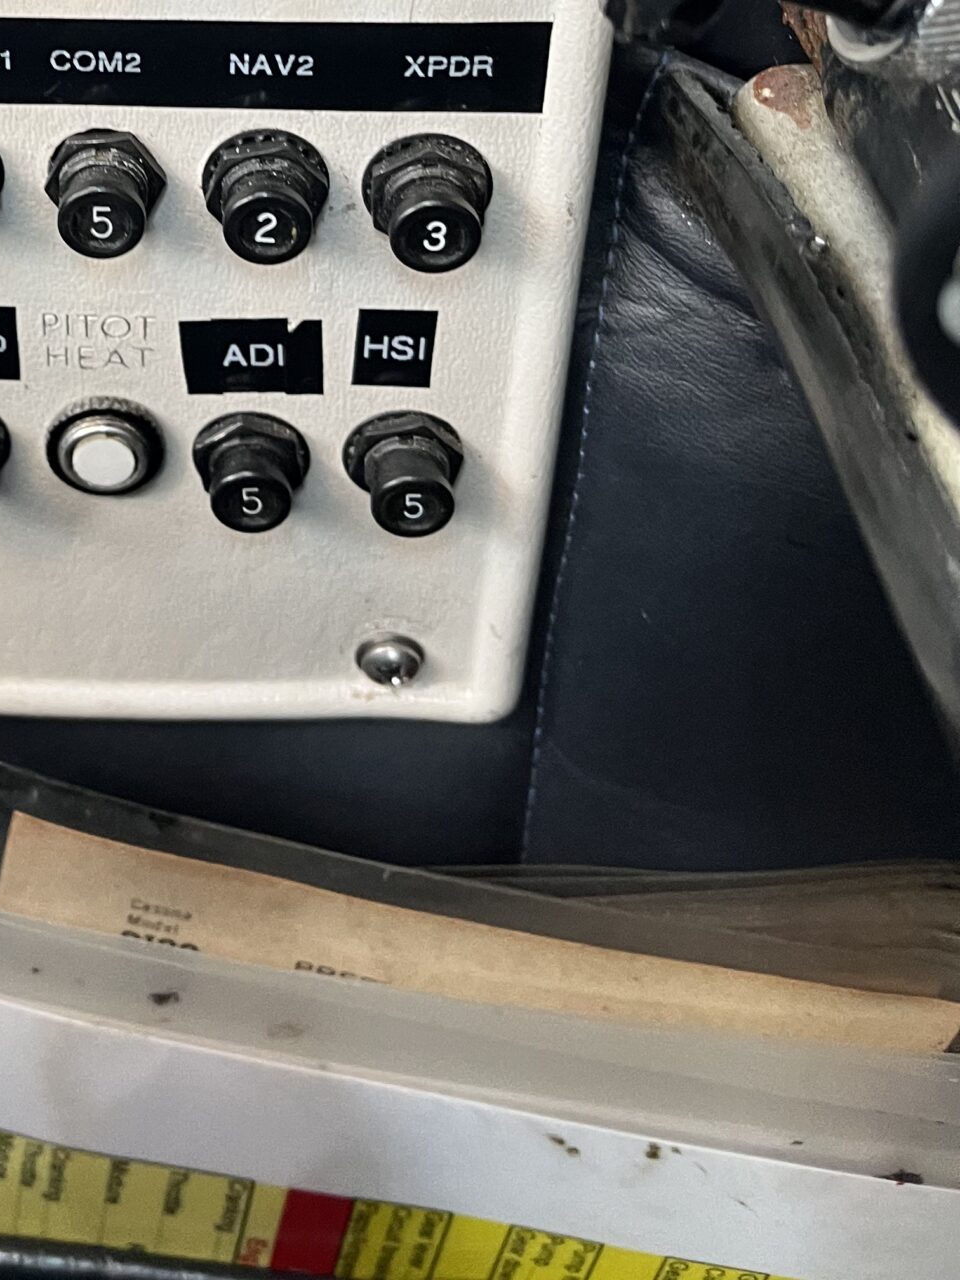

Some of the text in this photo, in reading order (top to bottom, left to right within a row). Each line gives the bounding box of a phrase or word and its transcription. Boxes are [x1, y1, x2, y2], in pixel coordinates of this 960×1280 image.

[49, 49, 142, 73] COM2
[229, 53, 314, 77] NAV2
[404, 55, 494, 78] XPDR
[89, 206, 114, 239] 5
[253, 212, 279, 244] 2
[422, 220, 448, 252] 3
[42, 313, 157, 340] PITOT
[46, 346, 155, 370] HEAT
[222, 343, 285, 368] ADI
[362, 334, 426, 361] HSI
[241, 487, 264, 515] 5
[402, 493, 425, 520] 5
